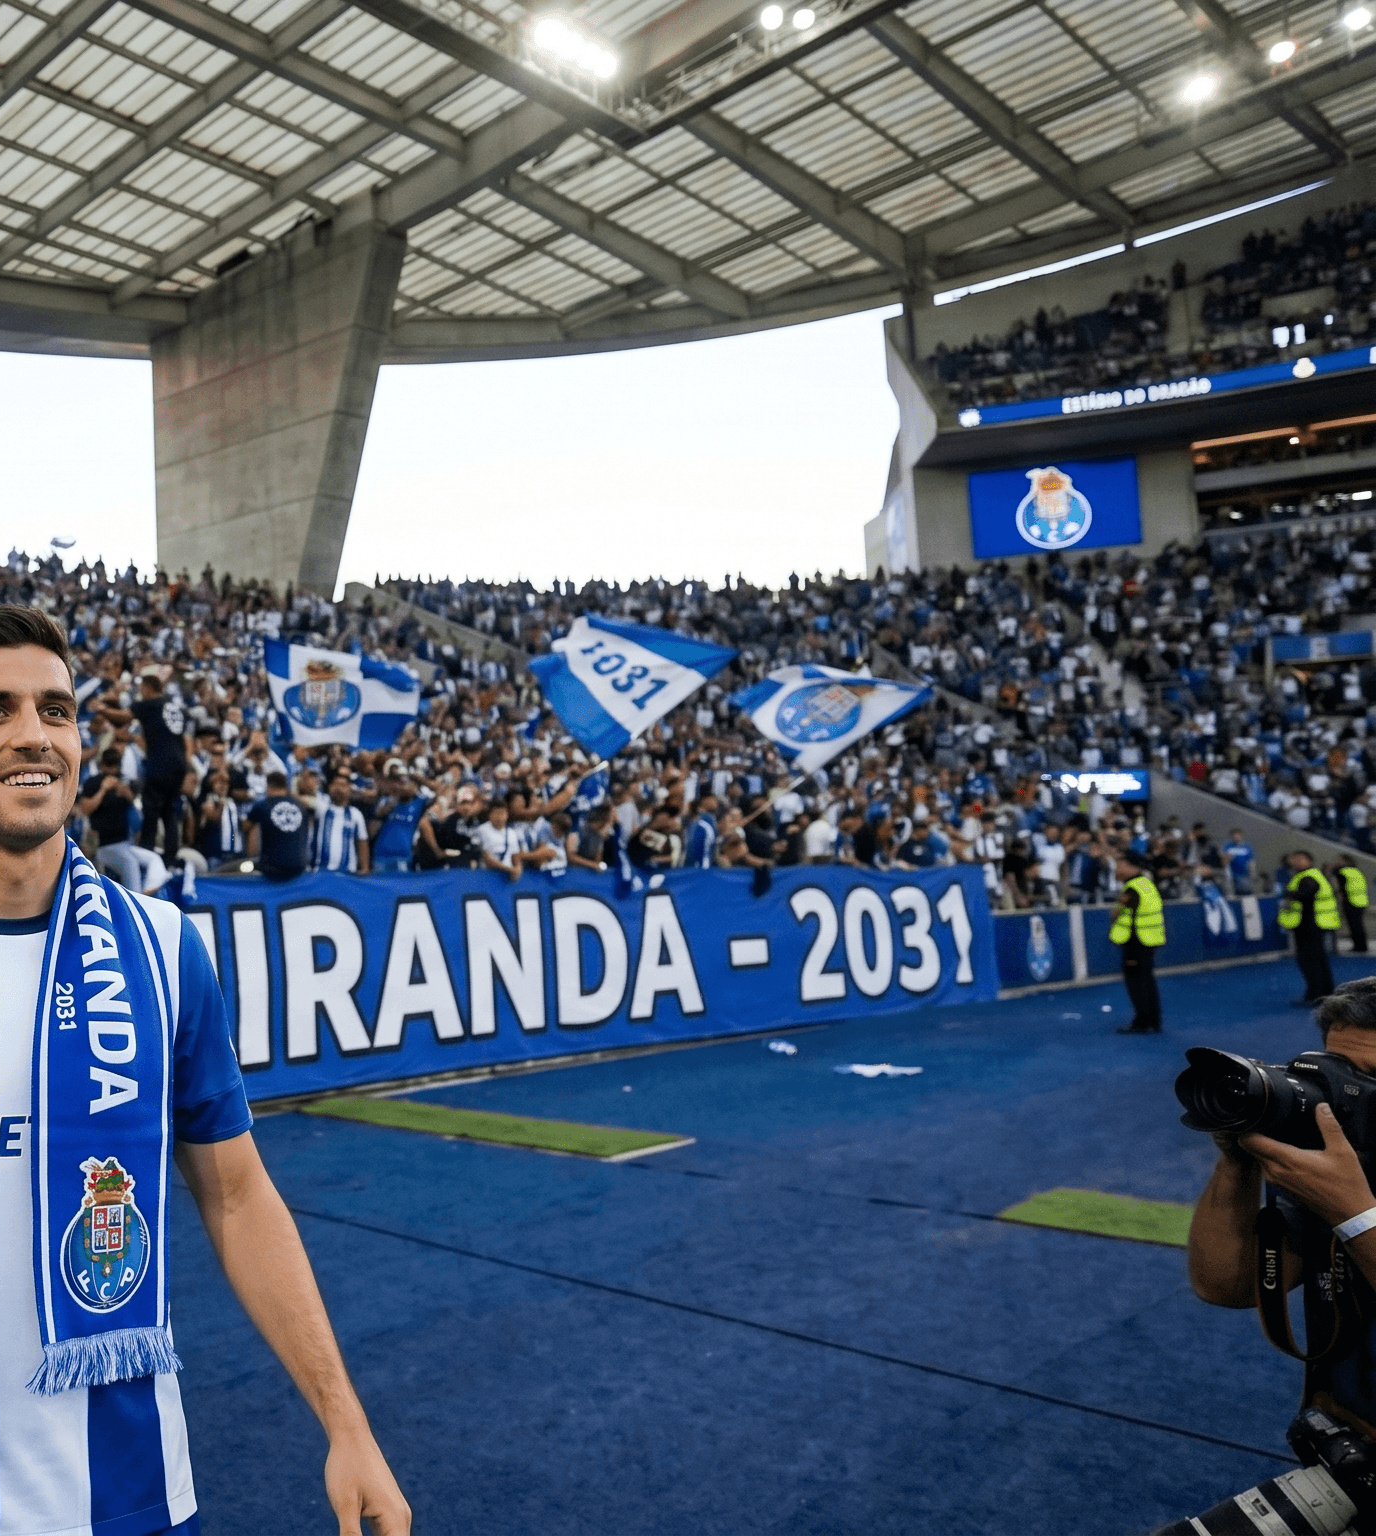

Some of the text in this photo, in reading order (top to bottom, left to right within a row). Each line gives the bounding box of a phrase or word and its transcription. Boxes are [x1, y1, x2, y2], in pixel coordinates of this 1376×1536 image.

[184, 891, 706, 1069] IRANDA
[788, 883, 975, 1003] 2031
[55, 981, 78, 1031] 2031
[77, 1266, 135, 1300] FCP
